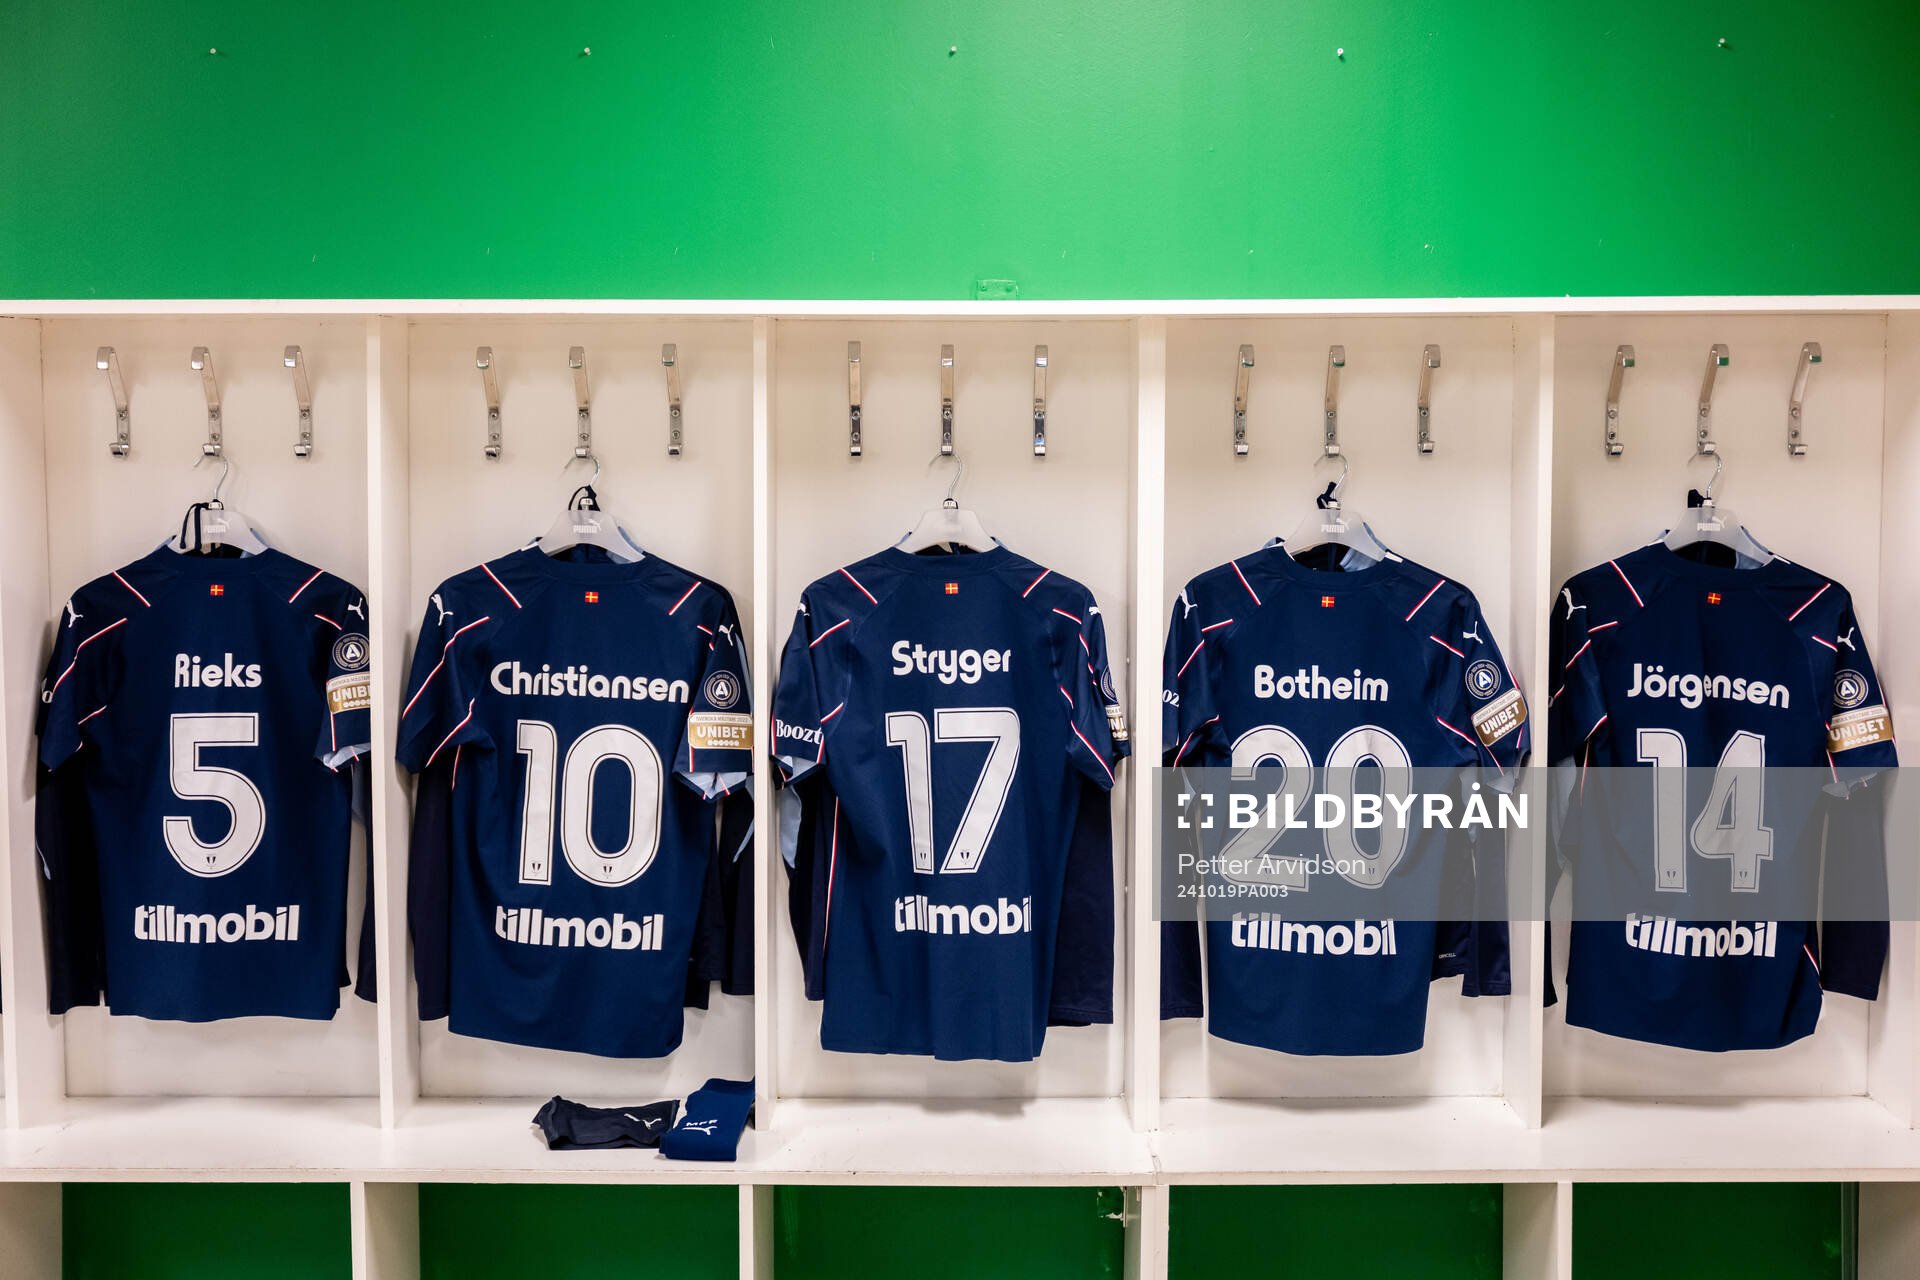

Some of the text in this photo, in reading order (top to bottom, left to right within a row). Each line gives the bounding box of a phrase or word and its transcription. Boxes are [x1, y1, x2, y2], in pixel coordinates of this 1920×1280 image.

[174, 652, 262, 688] Rieks
[490, 661, 689, 703] Christiansen
[892, 640, 1011, 685] Stryger
[1254, 664, 1389, 702] Botheim
[1627, 663, 1790, 709] Jörgensen
[697, 726, 747, 739] UNIBET
[1481, 702, 1520, 735] UNIBET
[1830, 718, 1885, 741] UNIBET
[162, 712, 266, 878] 5
[516, 719, 664, 888] 10
[885, 706, 1021, 875] 17
[1218, 724, 1414, 893] 20
[1636, 727, 1774, 893] 14
[134, 904, 300, 944] tillmobil
[495, 905, 664, 951] tillmobil
[894, 894, 1032, 935] tillmobi
[1231, 911, 1397, 956] tillmobil
[1625, 911, 1778, 958] tillmobil
